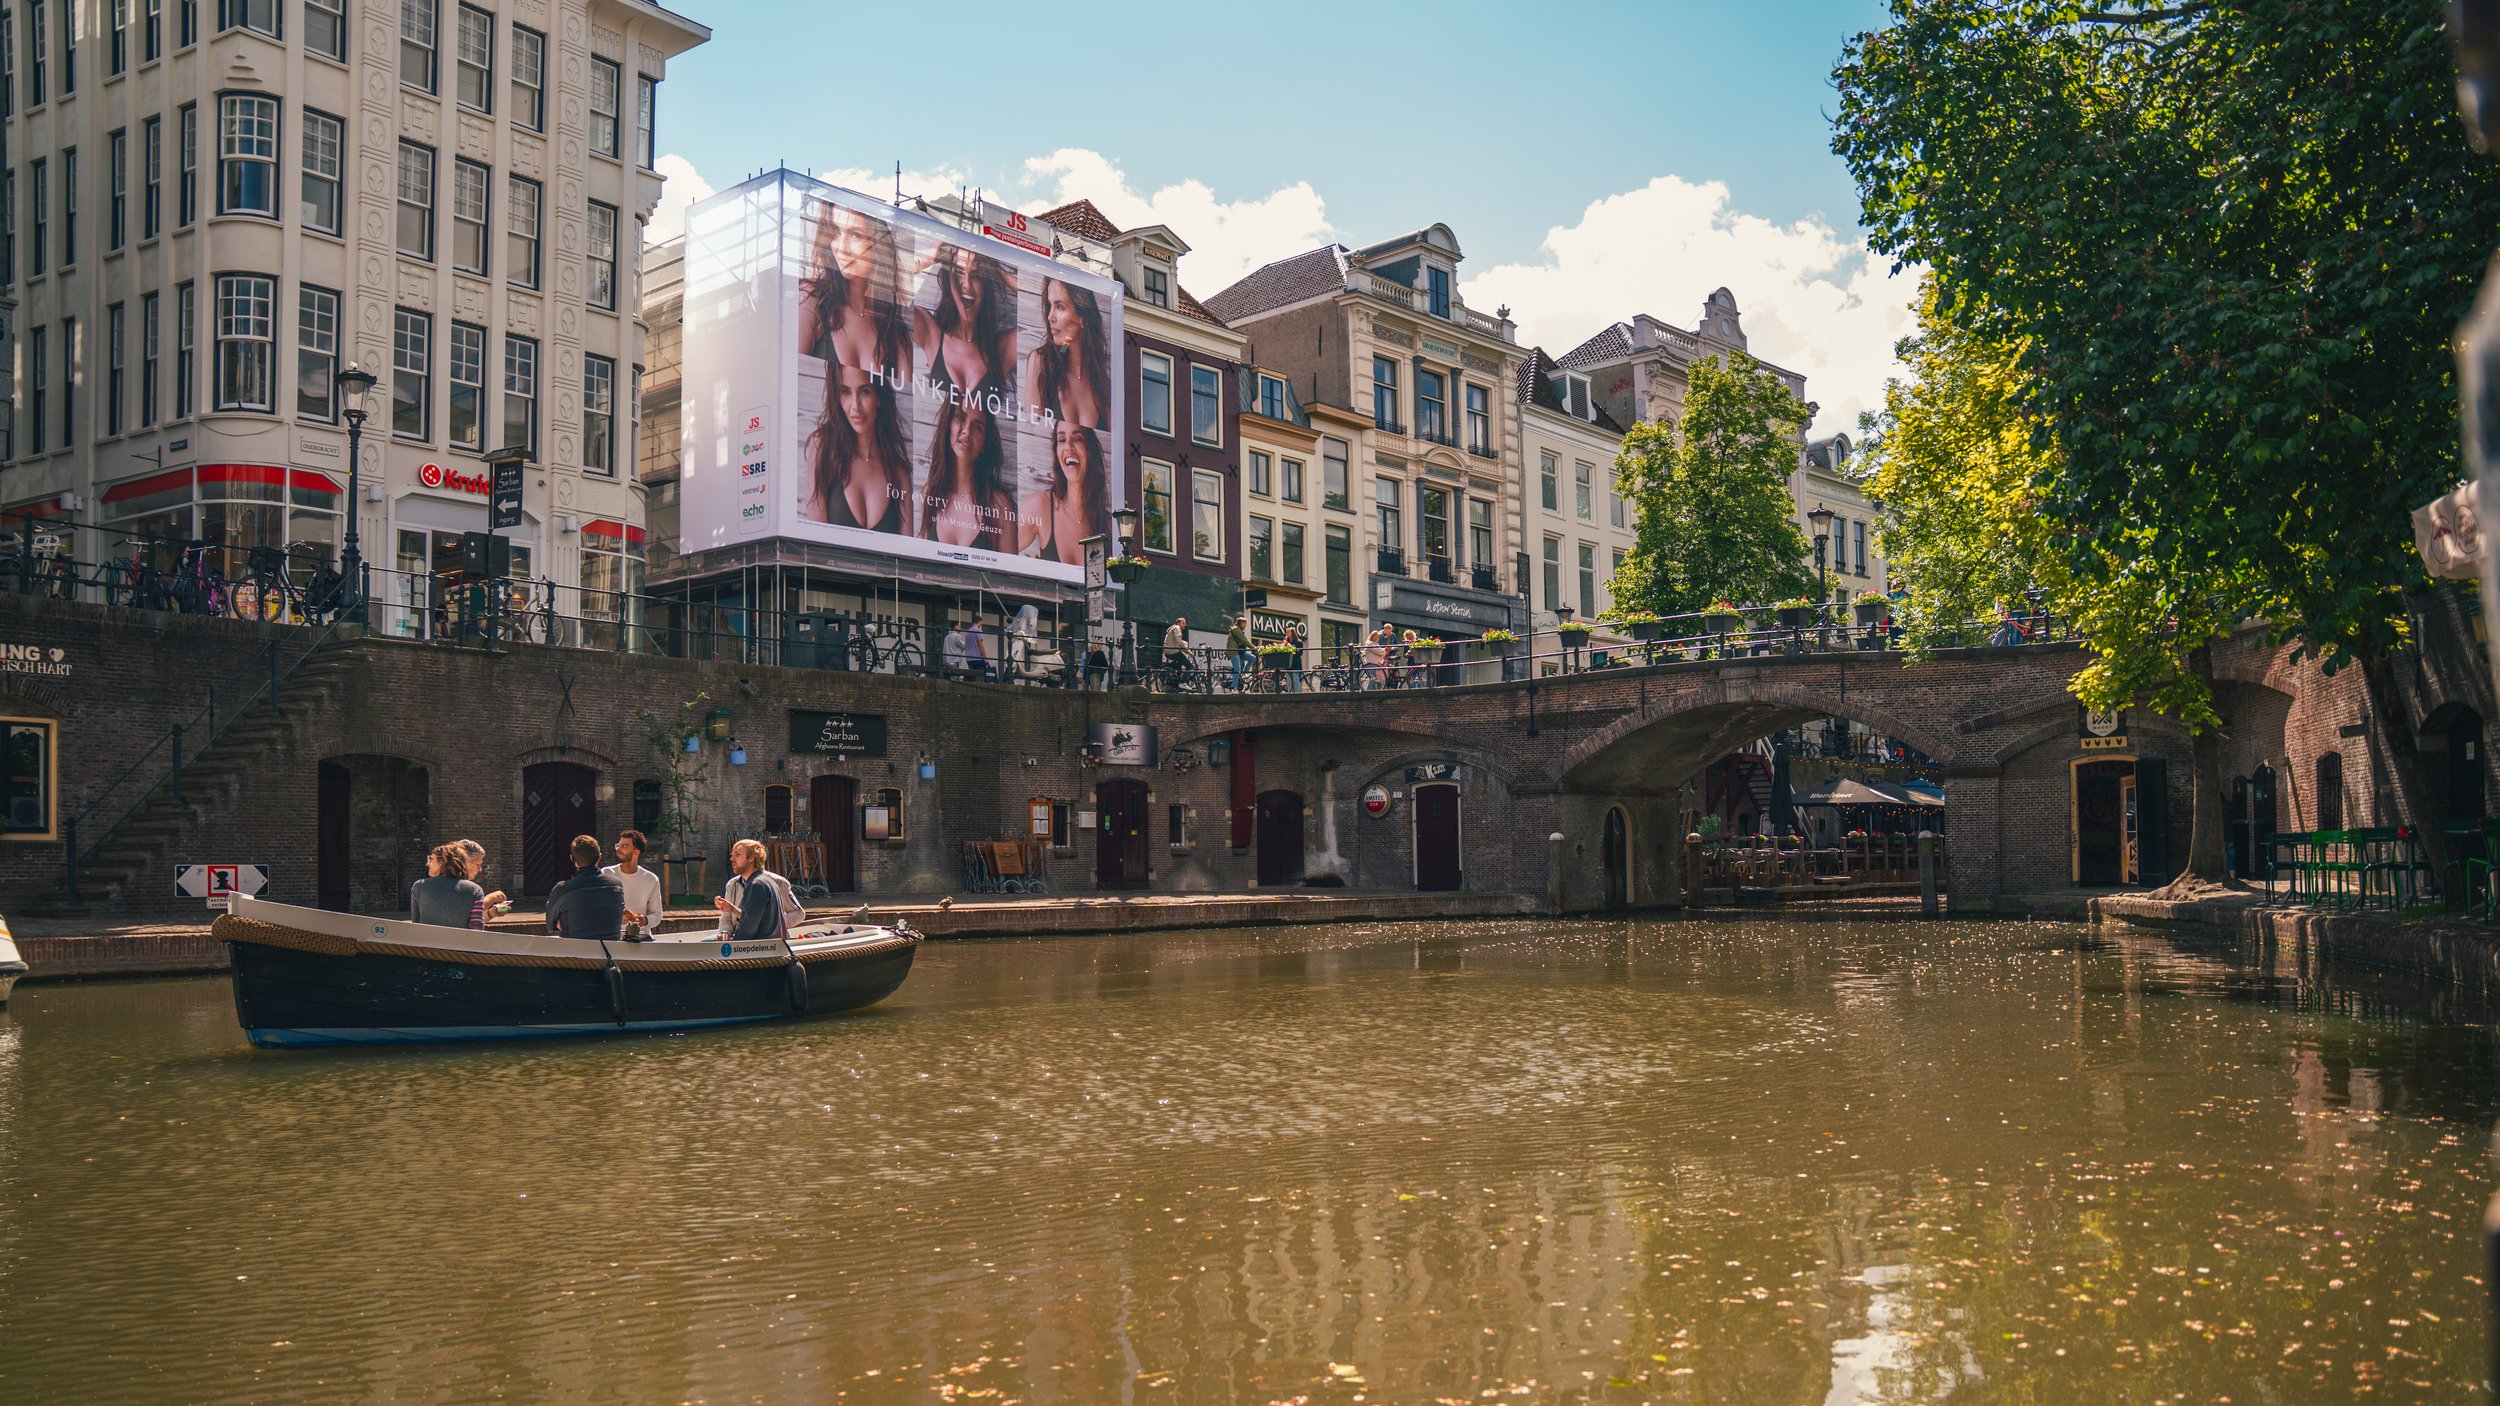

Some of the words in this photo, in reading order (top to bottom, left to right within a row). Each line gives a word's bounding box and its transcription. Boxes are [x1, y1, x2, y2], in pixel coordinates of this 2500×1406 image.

[1007, 211, 1027, 232] JS
[869, 361, 1055, 429] HUNKEMÖLLER
[749, 417, 760, 429] JS
[749, 461, 766, 474] SRE
[743, 504, 764, 517] echo
[886, 482, 907, 500] for
[911, 494, 949, 512] every
[954, 501, 1000, 519] woman
[1004, 507, 1016, 522] in
[1020, 513, 1043, 527] you
[949, 517, 977, 530] Monica
[979, 524, 1003, 535] Geuze
[1252, 614, 1307, 637] MANGO
[0, 643, 40, 661] ING
[37, 662, 73, 676] HART
[820, 727, 859, 741] Sarban
[838, 743, 865, 751] Restaurant
[733, 944, 777, 954] sloepdelen.nl
